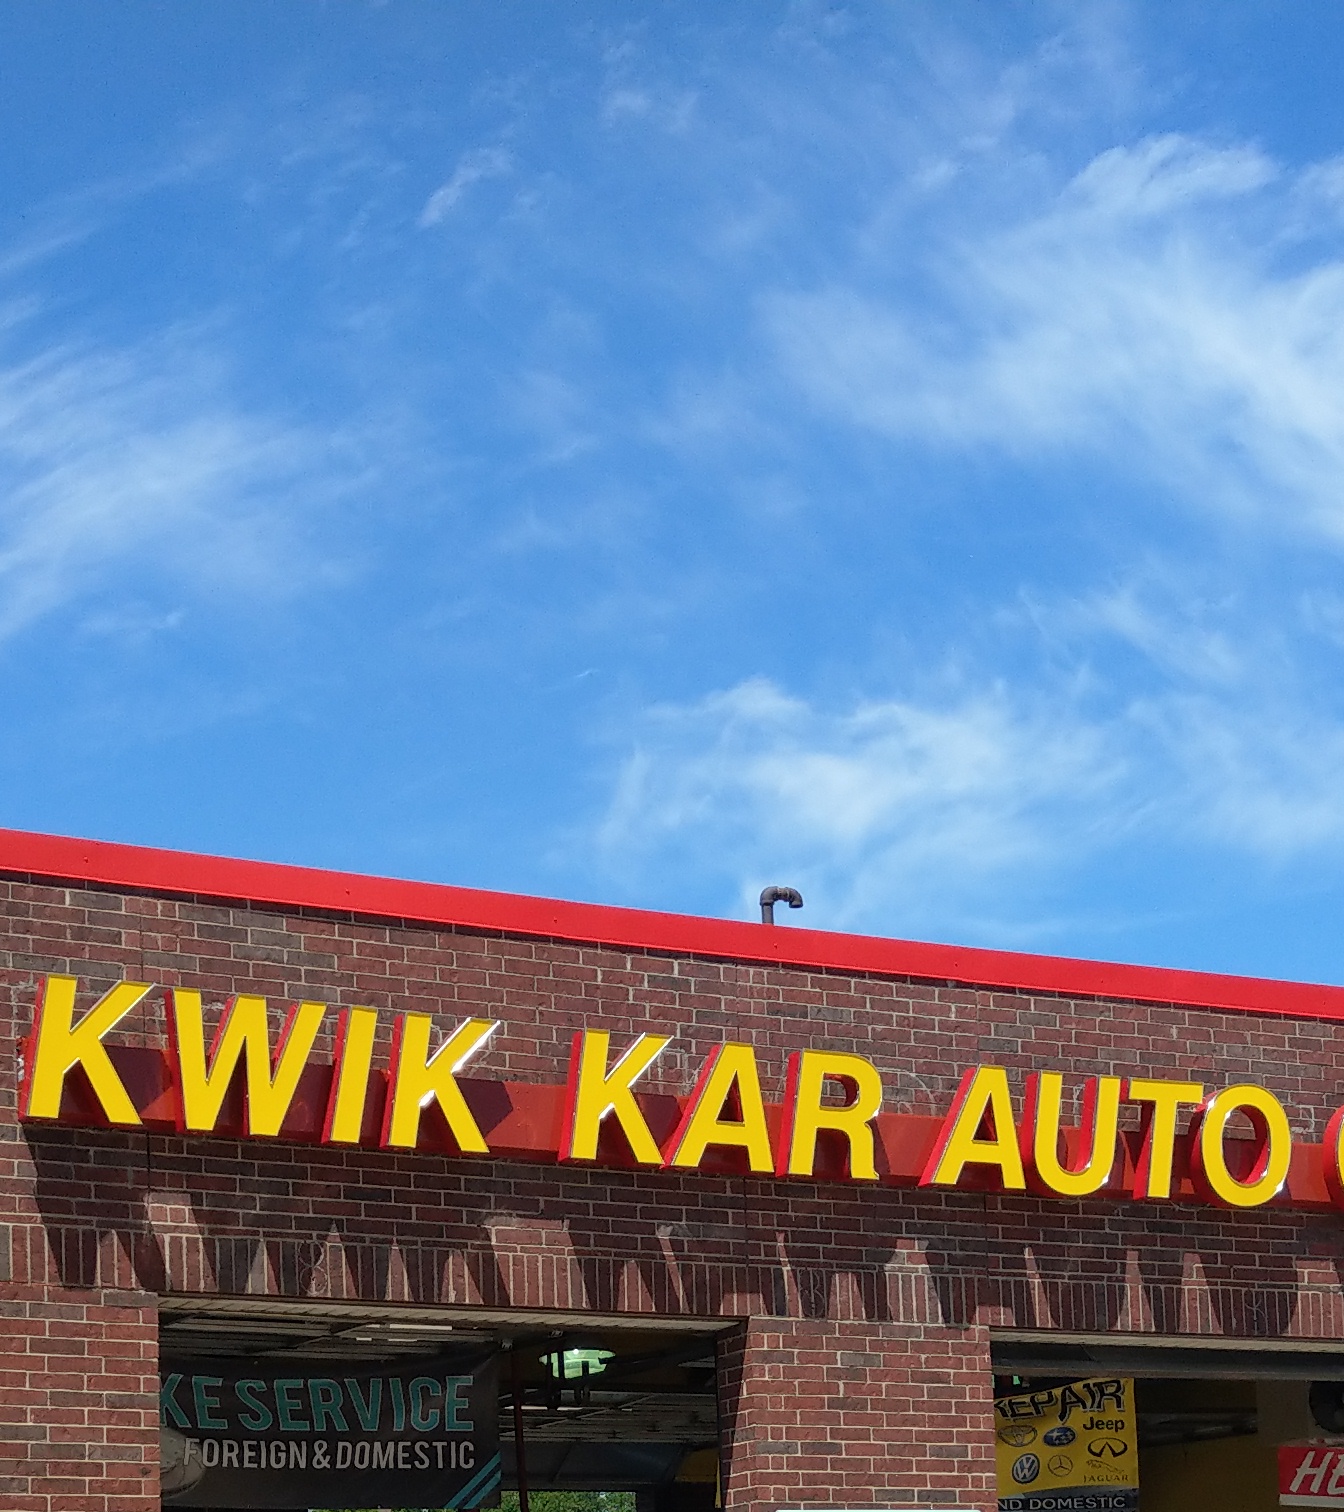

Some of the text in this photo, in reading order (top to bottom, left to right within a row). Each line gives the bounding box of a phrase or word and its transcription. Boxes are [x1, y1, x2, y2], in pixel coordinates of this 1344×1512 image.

[21, 975, 502, 1154] KWIK
[561, 1027, 882, 1180] KAR
[920, 1064, 1293, 1208] AUTO
[235, 1375, 475, 1432] SERVICE
[1083, 1417, 1125, 1433] Jeep
[184, 1437, 475, 1469] FOREIGN & DOMESTIC
[1083, 1475, 1129, 1484] JAGUAR
[1029, 1496, 1126, 1510] DOMESTIC
